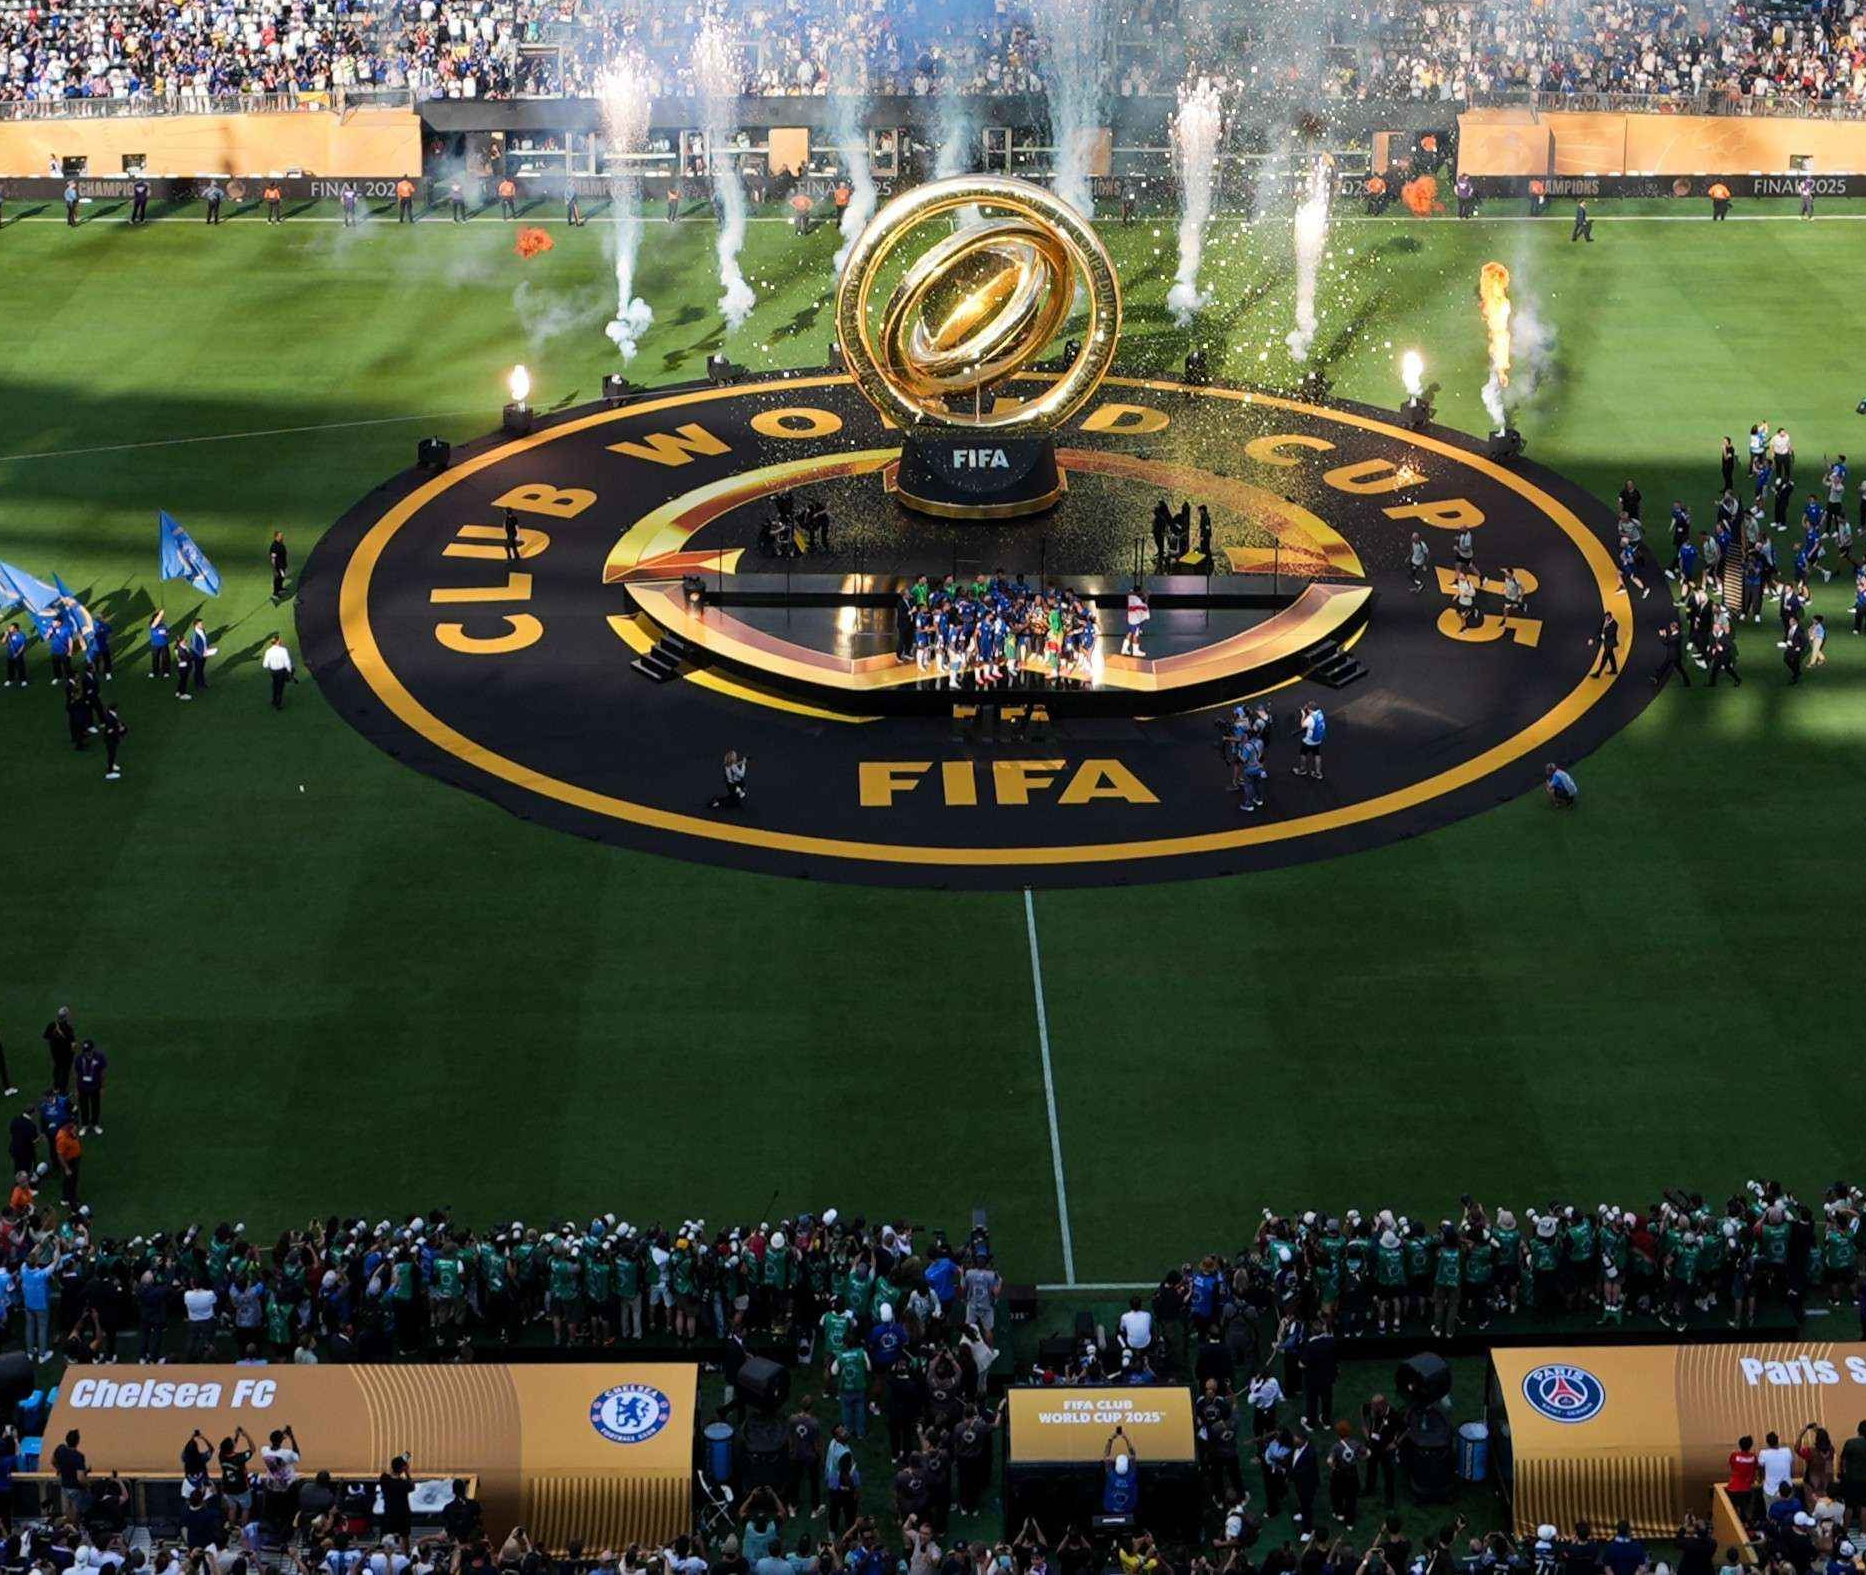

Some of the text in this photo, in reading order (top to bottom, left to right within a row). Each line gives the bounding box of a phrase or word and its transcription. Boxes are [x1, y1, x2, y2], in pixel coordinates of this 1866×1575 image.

[365, 181, 398, 197] 202
[952, 448, 1011, 469] FIFA
[430, 482, 598, 654] CLUB
[1243, 434, 1485, 530] CUP
[1434, 564, 1544, 648] 25
[859, 759, 1162, 807] FIFA
[1533, 1368, 1585, 1381] PARIS
[1740, 1355, 1840, 1385] Paris
[69, 1378, 277, 1408] Chelsea FC
[604, 1385, 659, 1398] CHELSEA
[1063, 1399, 1133, 1411] FIFA CLUB
[1038, 1411, 1091, 1424] WORLD
[1093, 1411, 1122, 1424] CUP
